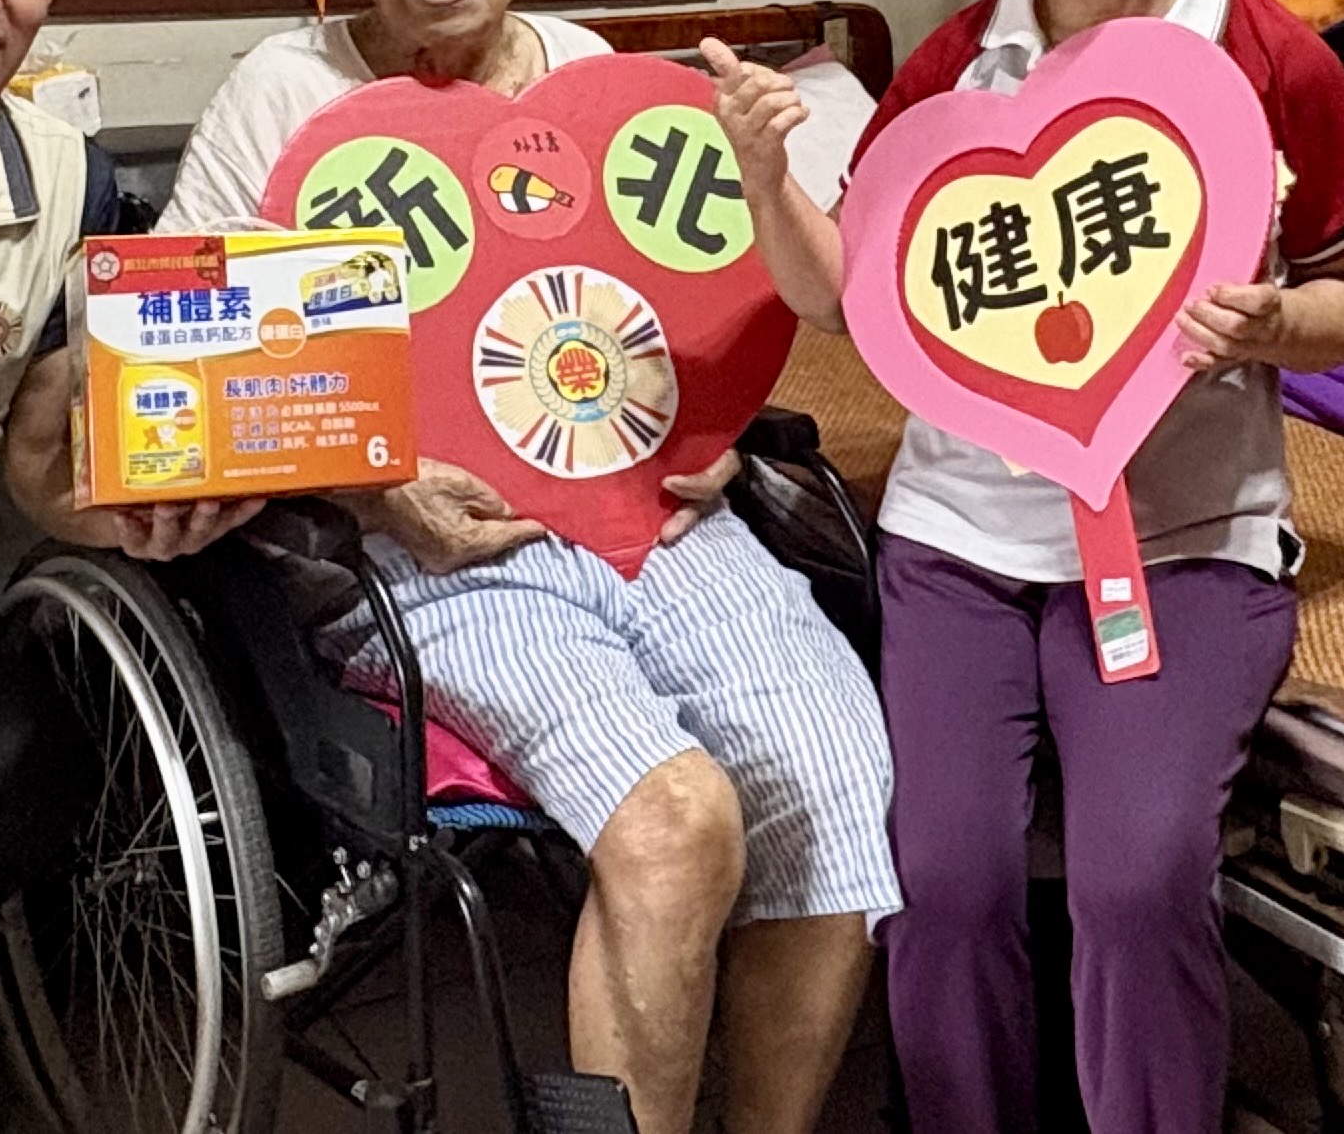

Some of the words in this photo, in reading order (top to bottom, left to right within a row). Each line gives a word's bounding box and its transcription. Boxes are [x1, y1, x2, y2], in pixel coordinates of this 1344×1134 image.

[617, 126, 743, 255] 北
[930, 152, 1171, 331] 健康
[137, 286, 252, 326] 補體素
[140, 326, 253, 347] 優蛋白高鈣配方
[366, 435, 390, 468] 6
